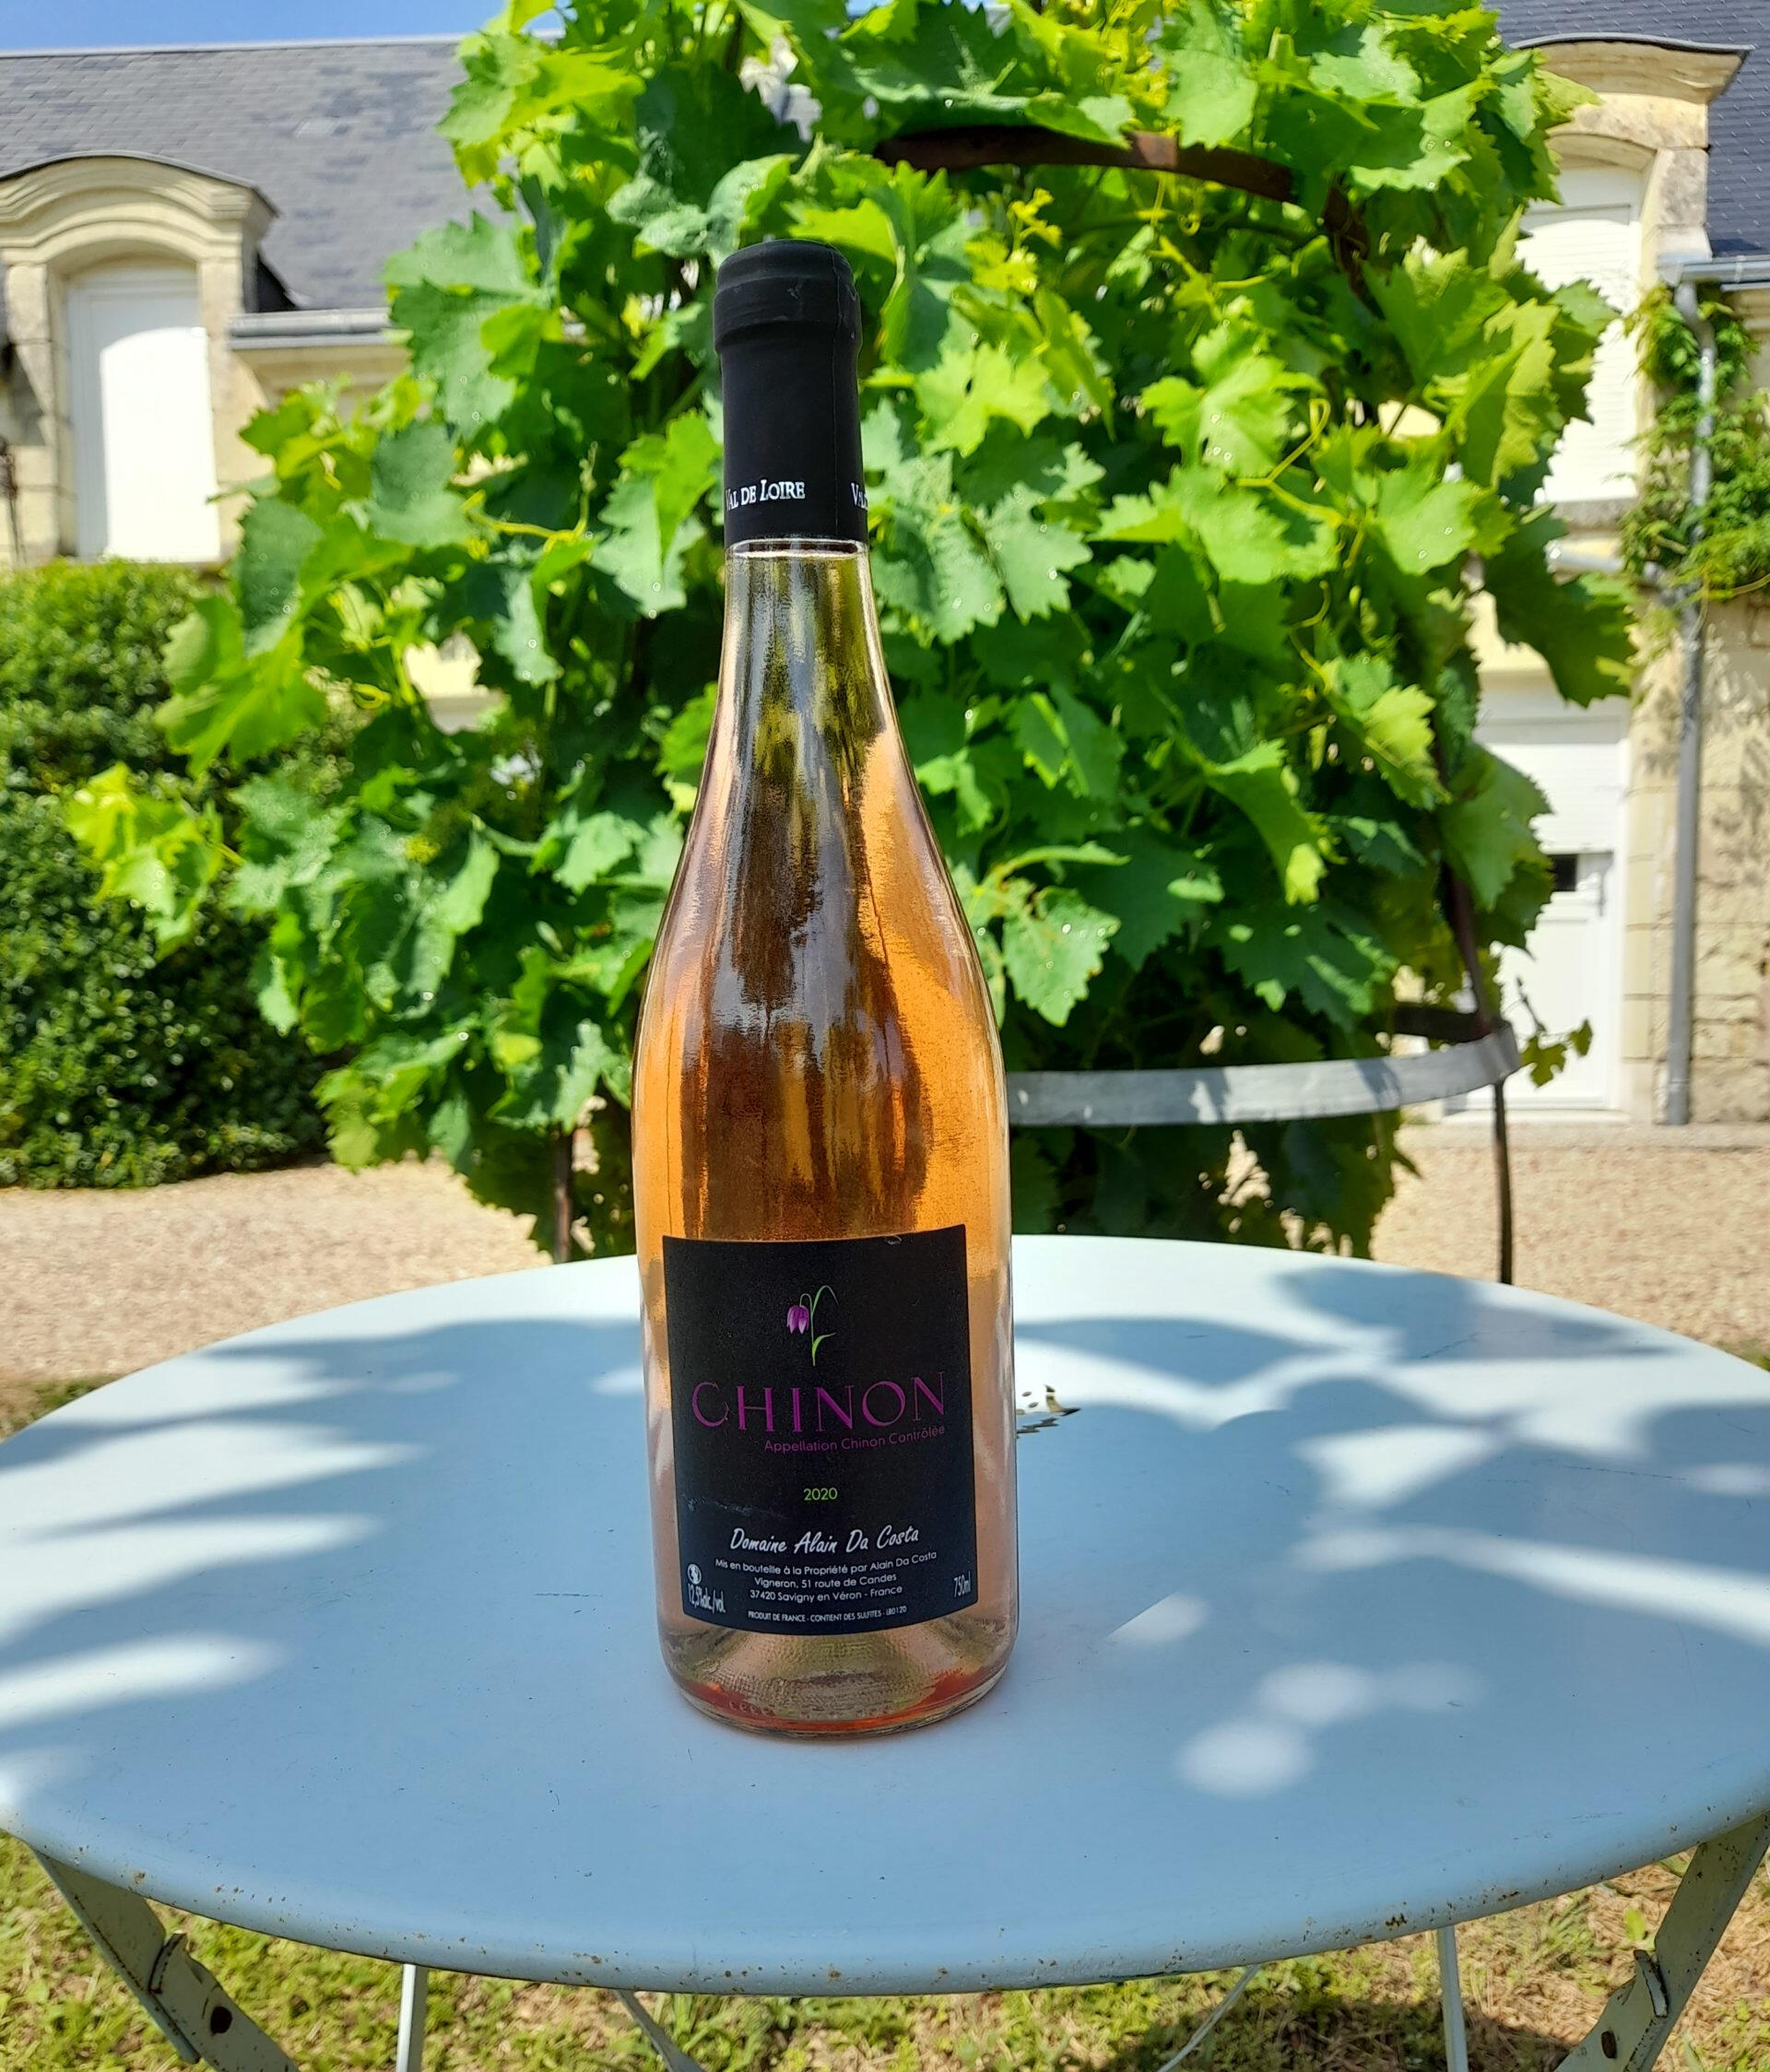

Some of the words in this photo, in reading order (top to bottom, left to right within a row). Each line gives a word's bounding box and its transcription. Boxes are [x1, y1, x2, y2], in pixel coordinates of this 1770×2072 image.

[725, 489, 738, 510] VAL
[740, 486, 757, 506] DE
[760, 479, 805, 501] LOIRE
[691, 1372, 945, 1432] CHINON
[764, 1439, 838, 1453] Appellation
[841, 1436, 885, 1450] Chinon
[889, 1425, 945, 1443] Contrôlée
[803, 1487, 838, 1501] 2020
[730, 1528, 787, 1554] Domaine
[794, 1531, 838, 1554] Alain
[846, 1529, 868, 1553] Da
[877, 1525, 919, 1549] Costa
[715, 1559, 728, 1569] Mis
[743, 1563, 781, 1575] bouteille
[784, 1566, 791, 1575] à
[793, 1566, 802, 1575] la
[804, 1564, 848, 1577] Propriété
[850, 1564, 867, 1575] par
[870, 1560, 894, 1571] Alain
[896, 1558, 909, 1567] Da
[911, 1551, 937, 1564] Costa
[750, 1590, 776, 1600] 37420
[778, 1592, 815, 1603] Savigny
[832, 1589, 862, 1601] Véron
[870, 1586, 903, 1598] France
[755, 1577, 799, 1589] Vigneron,
[802, 1579, 811, 1588] 51
[814, 1579, 840, 1588] route
[843, 1578, 857, 1587] de
[859, 1573, 897, 1585] Candes
[953, 1570, 971, 1598] 750ml
[748, 1610, 771, 1620] PRODUIT
[773, 1613, 780, 1621] DE
[782, 1613, 806, 1622] FRANCE
[810, 1613, 842, 1622] CONTIENT
[844, 1611, 856, 1621] DES
